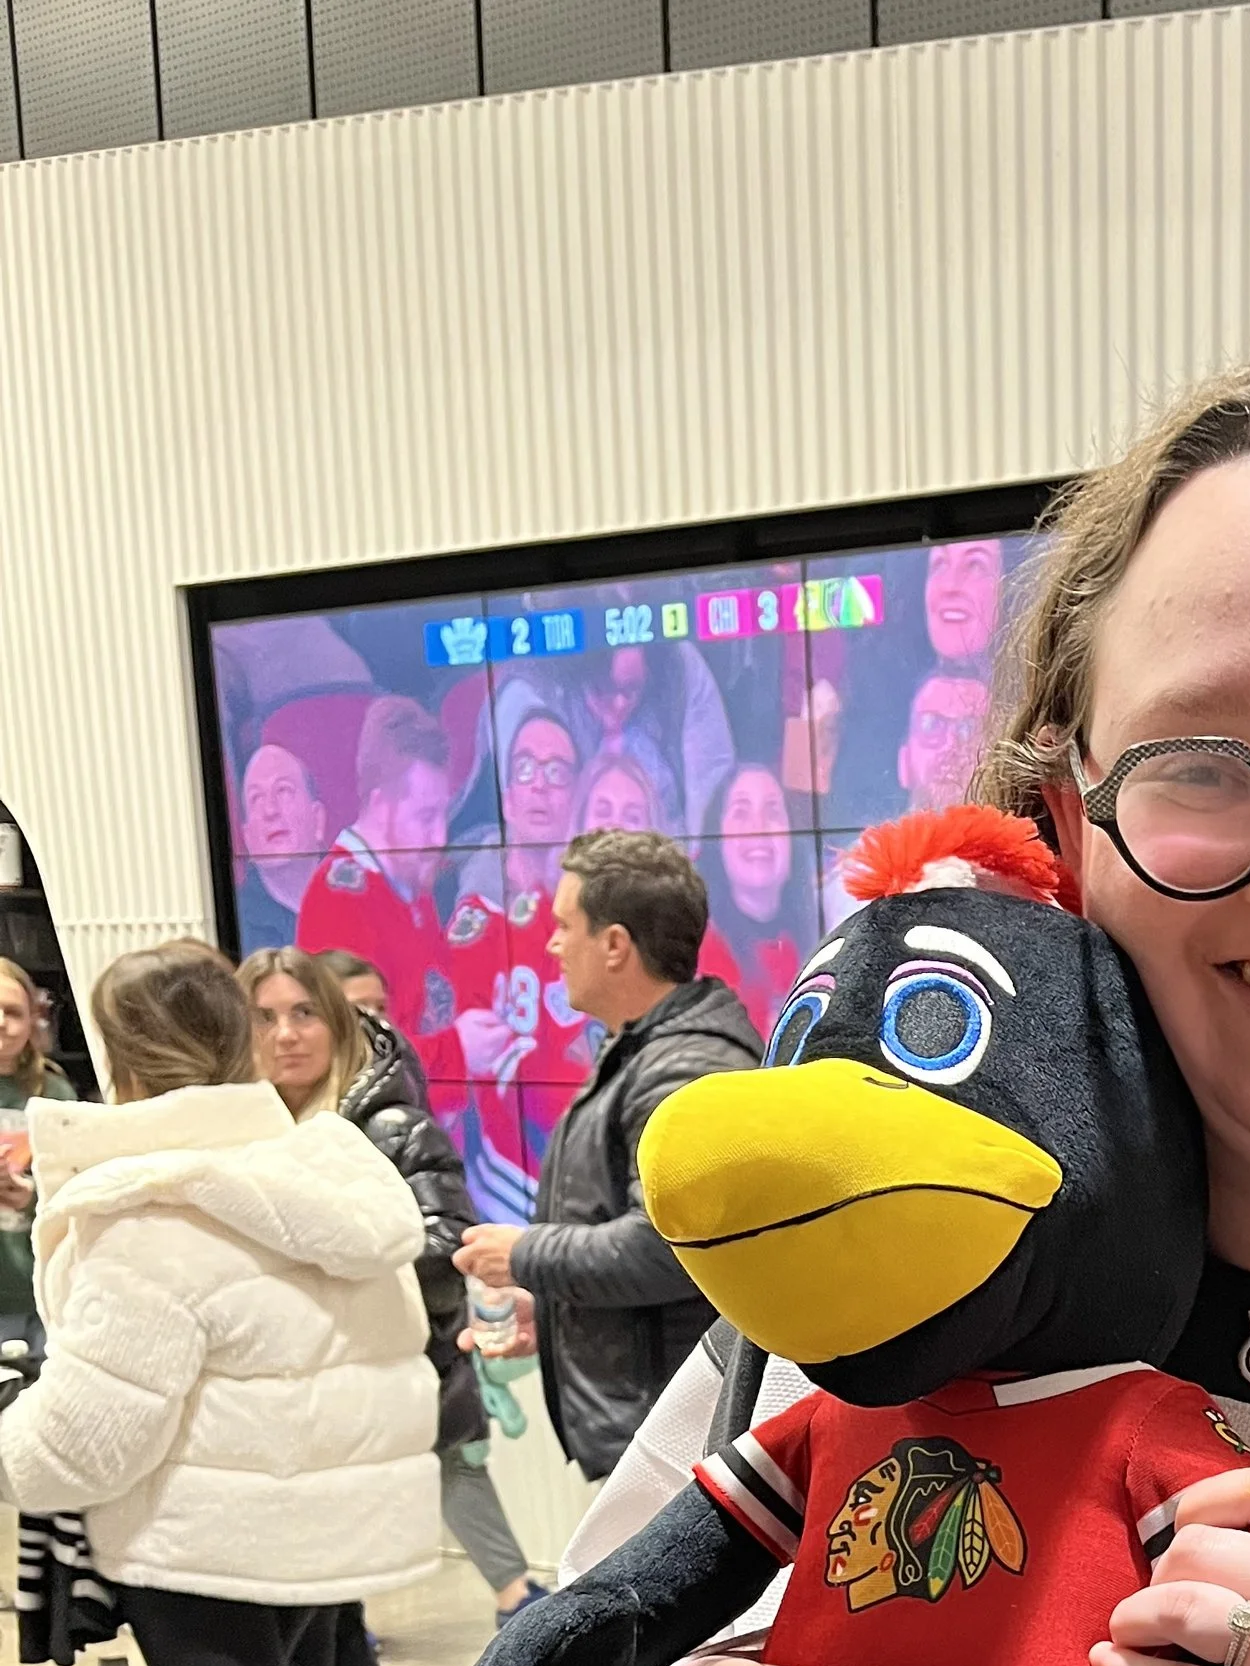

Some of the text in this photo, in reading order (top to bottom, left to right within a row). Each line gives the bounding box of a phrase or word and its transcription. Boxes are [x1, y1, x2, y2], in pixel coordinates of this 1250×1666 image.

[511, 618, 531, 655] 2
[605, 604, 654, 646] 5:02
[708, 596, 738, 635] CHI
[757, 591, 779, 632] 3
